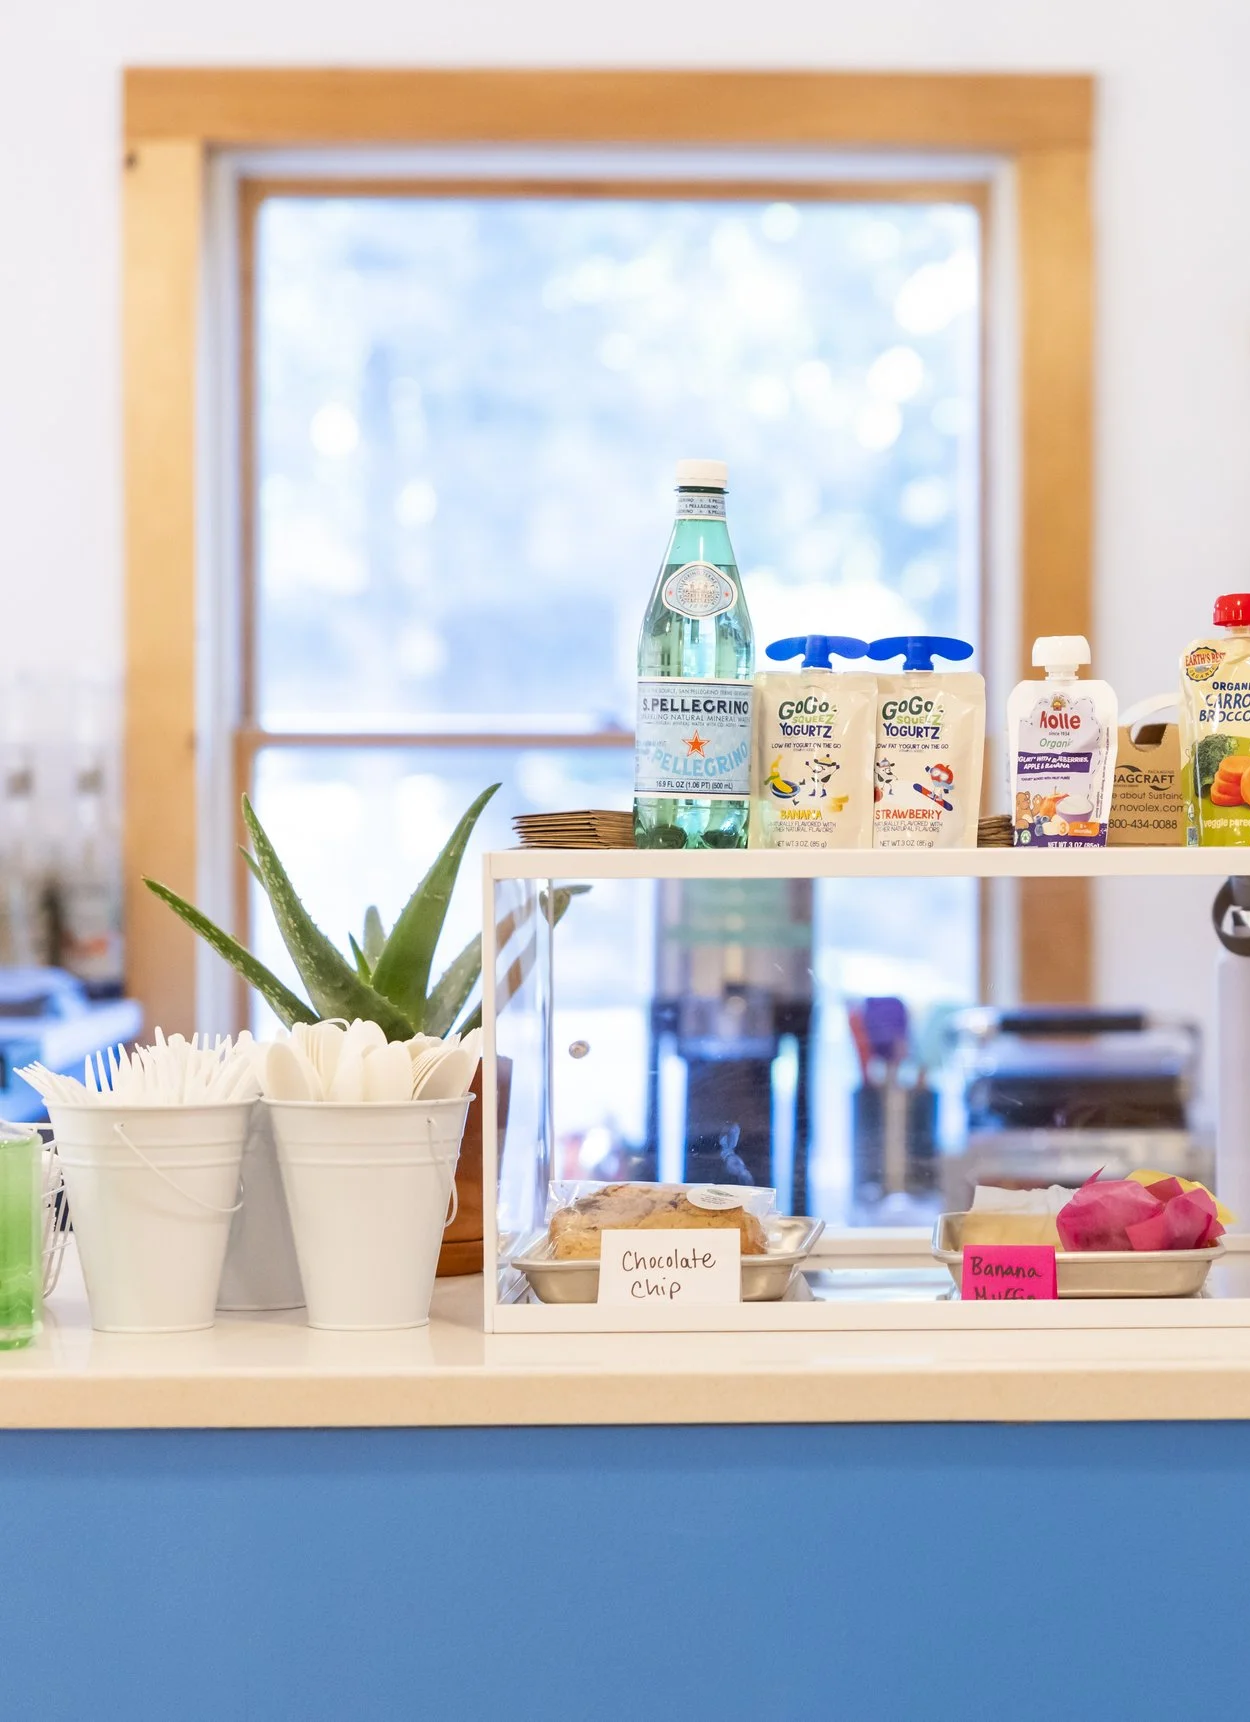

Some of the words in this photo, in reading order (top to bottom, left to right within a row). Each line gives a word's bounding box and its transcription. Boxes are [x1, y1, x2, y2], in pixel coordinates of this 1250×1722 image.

[670, 714, 704, 722] NATURAL
[779, 722, 832, 739] YOGURTZ
[883, 722, 940, 740] YOGURTZ
[1039, 738, 1074, 750] Organi
[675, 781, 685, 789] OZ
[1119, 791, 1147, 800] about
[779, 809, 823, 821] BANANA
[875, 808, 943, 821] STRAWBERRY
[622, 1248, 717, 1272] Chocolate
[969, 1255, 1043, 1279] Banana
[974, 1285, 1036, 1300] Muff
